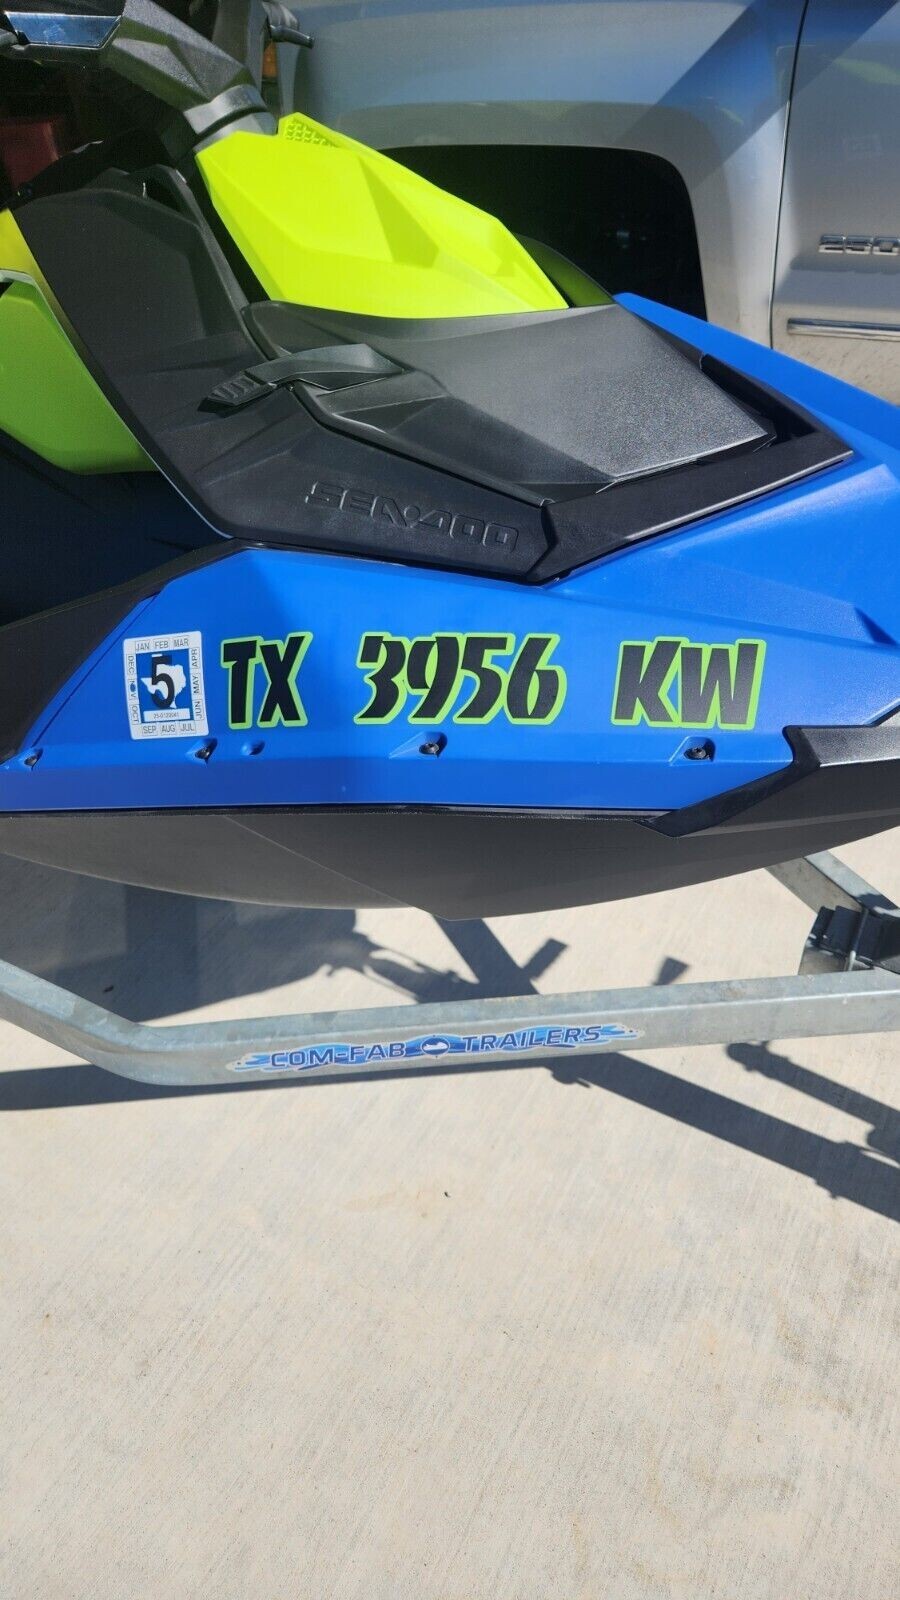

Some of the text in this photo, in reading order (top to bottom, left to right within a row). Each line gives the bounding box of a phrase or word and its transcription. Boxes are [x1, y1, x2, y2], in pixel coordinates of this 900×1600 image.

[135, 638, 189, 652] JAN FEB MAR
[191, 648, 199, 668] APR
[127, 655, 140, 724] DEC NV OCT
[221, 633, 765, 730] TX 3956 KW
[194, 700, 203, 719] JUN
[143, 723, 195, 734] SEP AUG JUL
[271, 1026, 601, 1067] COM-FAB TRAILERS
